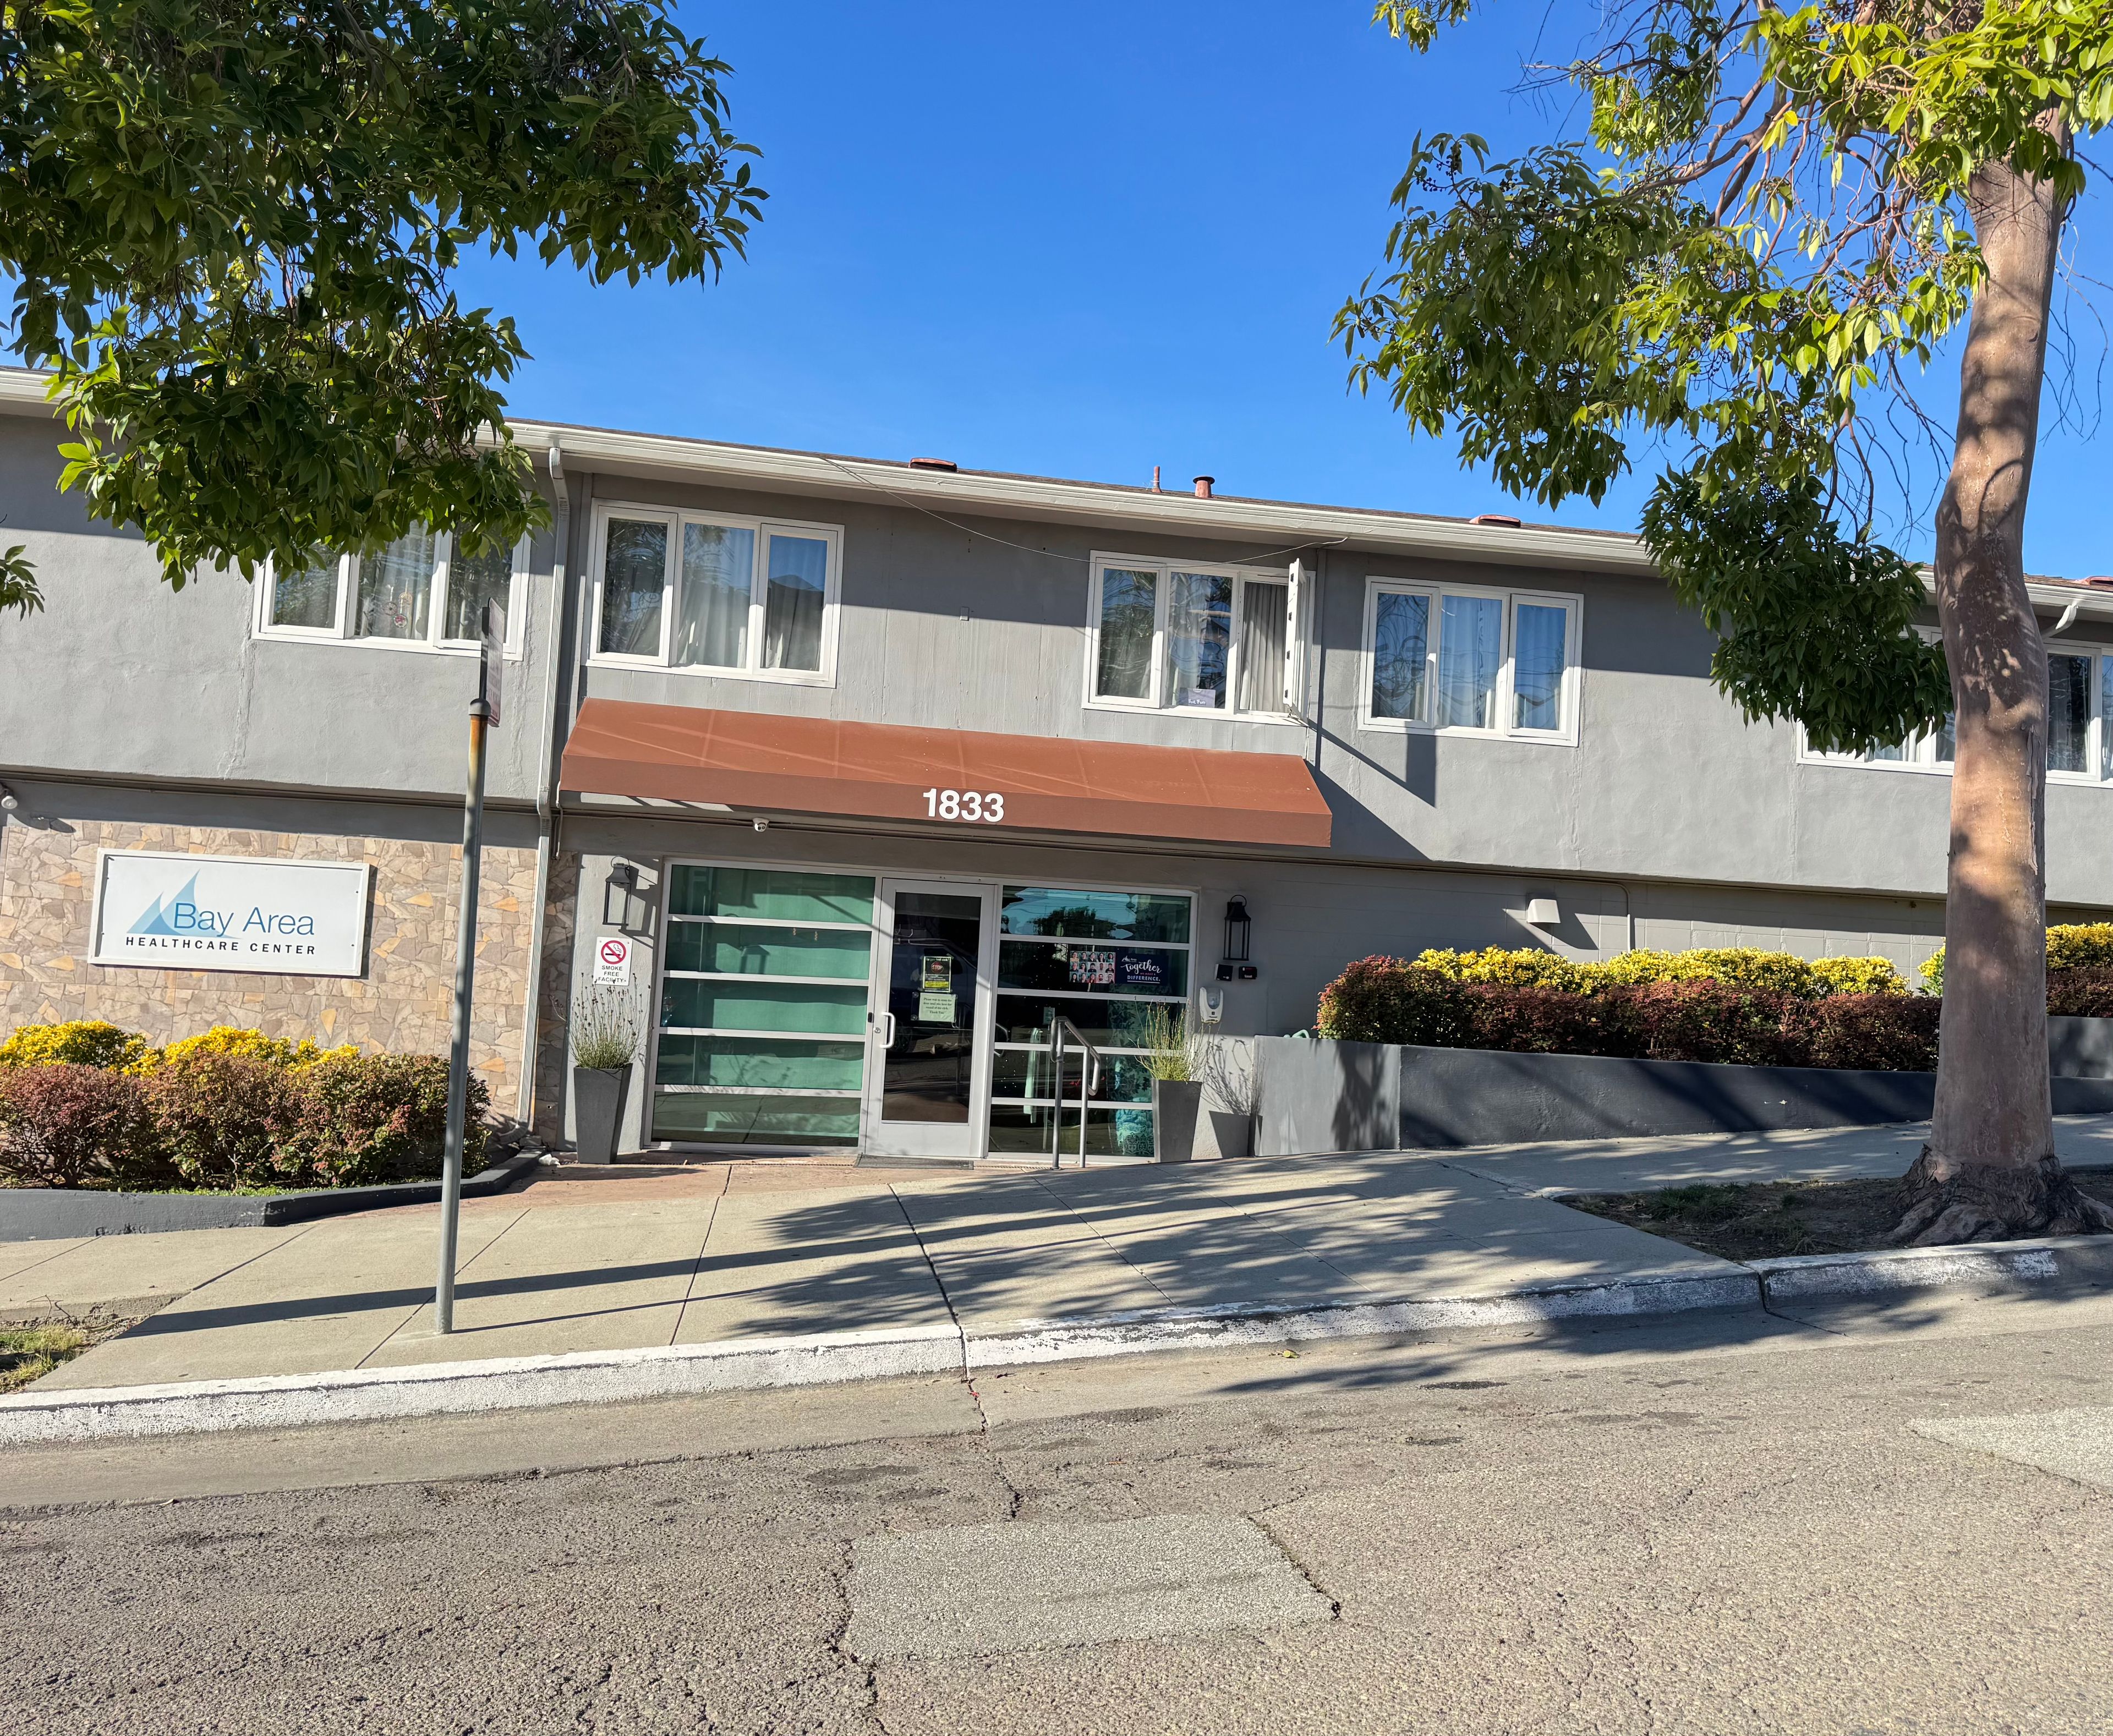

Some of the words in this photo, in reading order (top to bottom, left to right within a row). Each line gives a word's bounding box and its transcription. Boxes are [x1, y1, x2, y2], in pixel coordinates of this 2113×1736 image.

[923, 788, 1004, 823] 1833
[174, 902, 234, 937] Bay
[242, 907, 314, 935] Area
[126, 937, 239, 951] HEALTHCARE
[250, 943, 315, 955] CENTER
